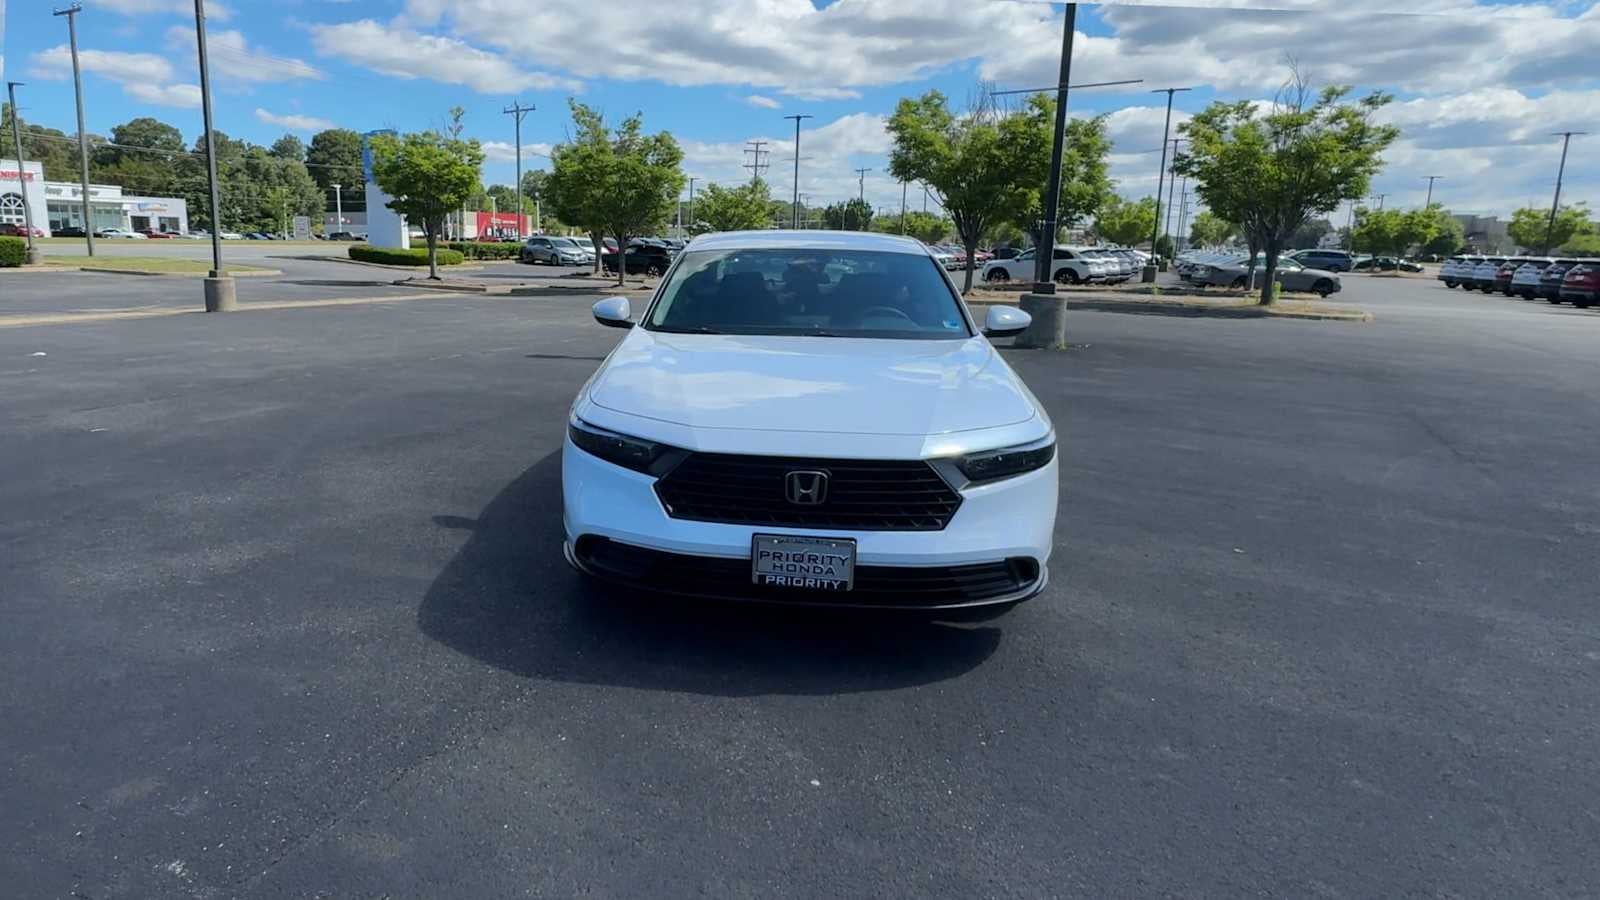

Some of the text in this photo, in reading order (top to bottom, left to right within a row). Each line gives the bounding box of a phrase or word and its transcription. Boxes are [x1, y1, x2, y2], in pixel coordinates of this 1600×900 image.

[760, 550, 848, 566] PRIORITY
[773, 562, 835, 575] HONDA
[766, 576, 840, 589] PRIORITY
